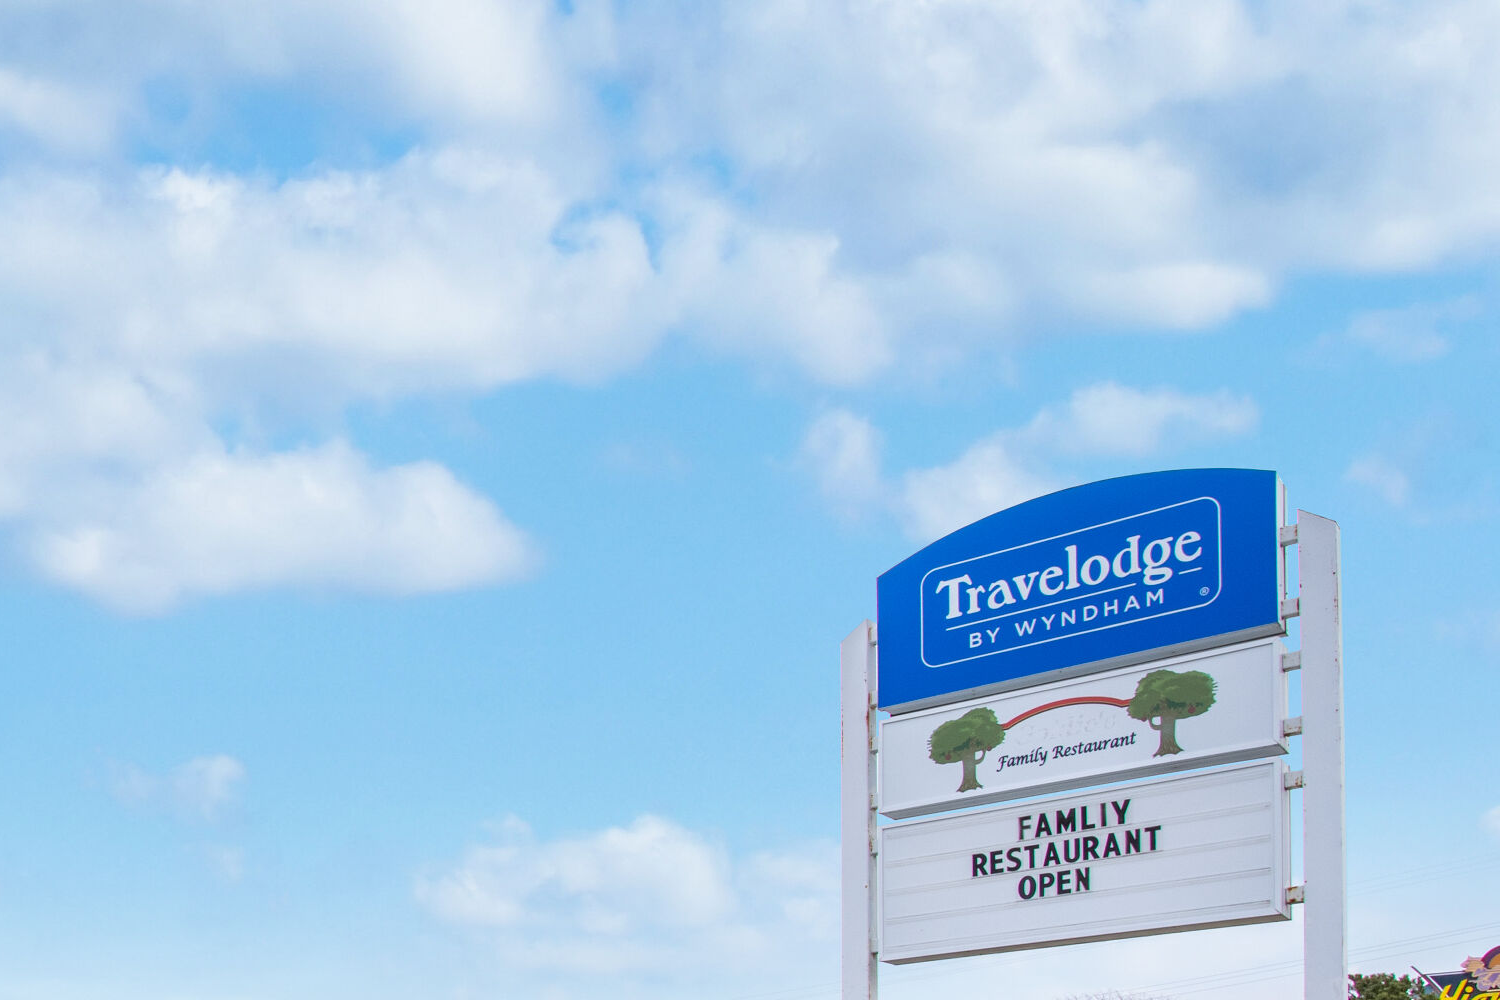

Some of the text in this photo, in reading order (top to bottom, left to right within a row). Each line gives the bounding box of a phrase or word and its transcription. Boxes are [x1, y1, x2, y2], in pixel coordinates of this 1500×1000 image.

[935, 531, 1203, 620] Travelodge
[969, 588, 1165, 649] BY WYNDHAM
[996, 731, 1137, 773] Family Restaurant
[1018, 799, 1131, 841] FAMLIY
[972, 825, 1161, 878] RESTAURANT
[1018, 867, 1090, 900] OPEN
